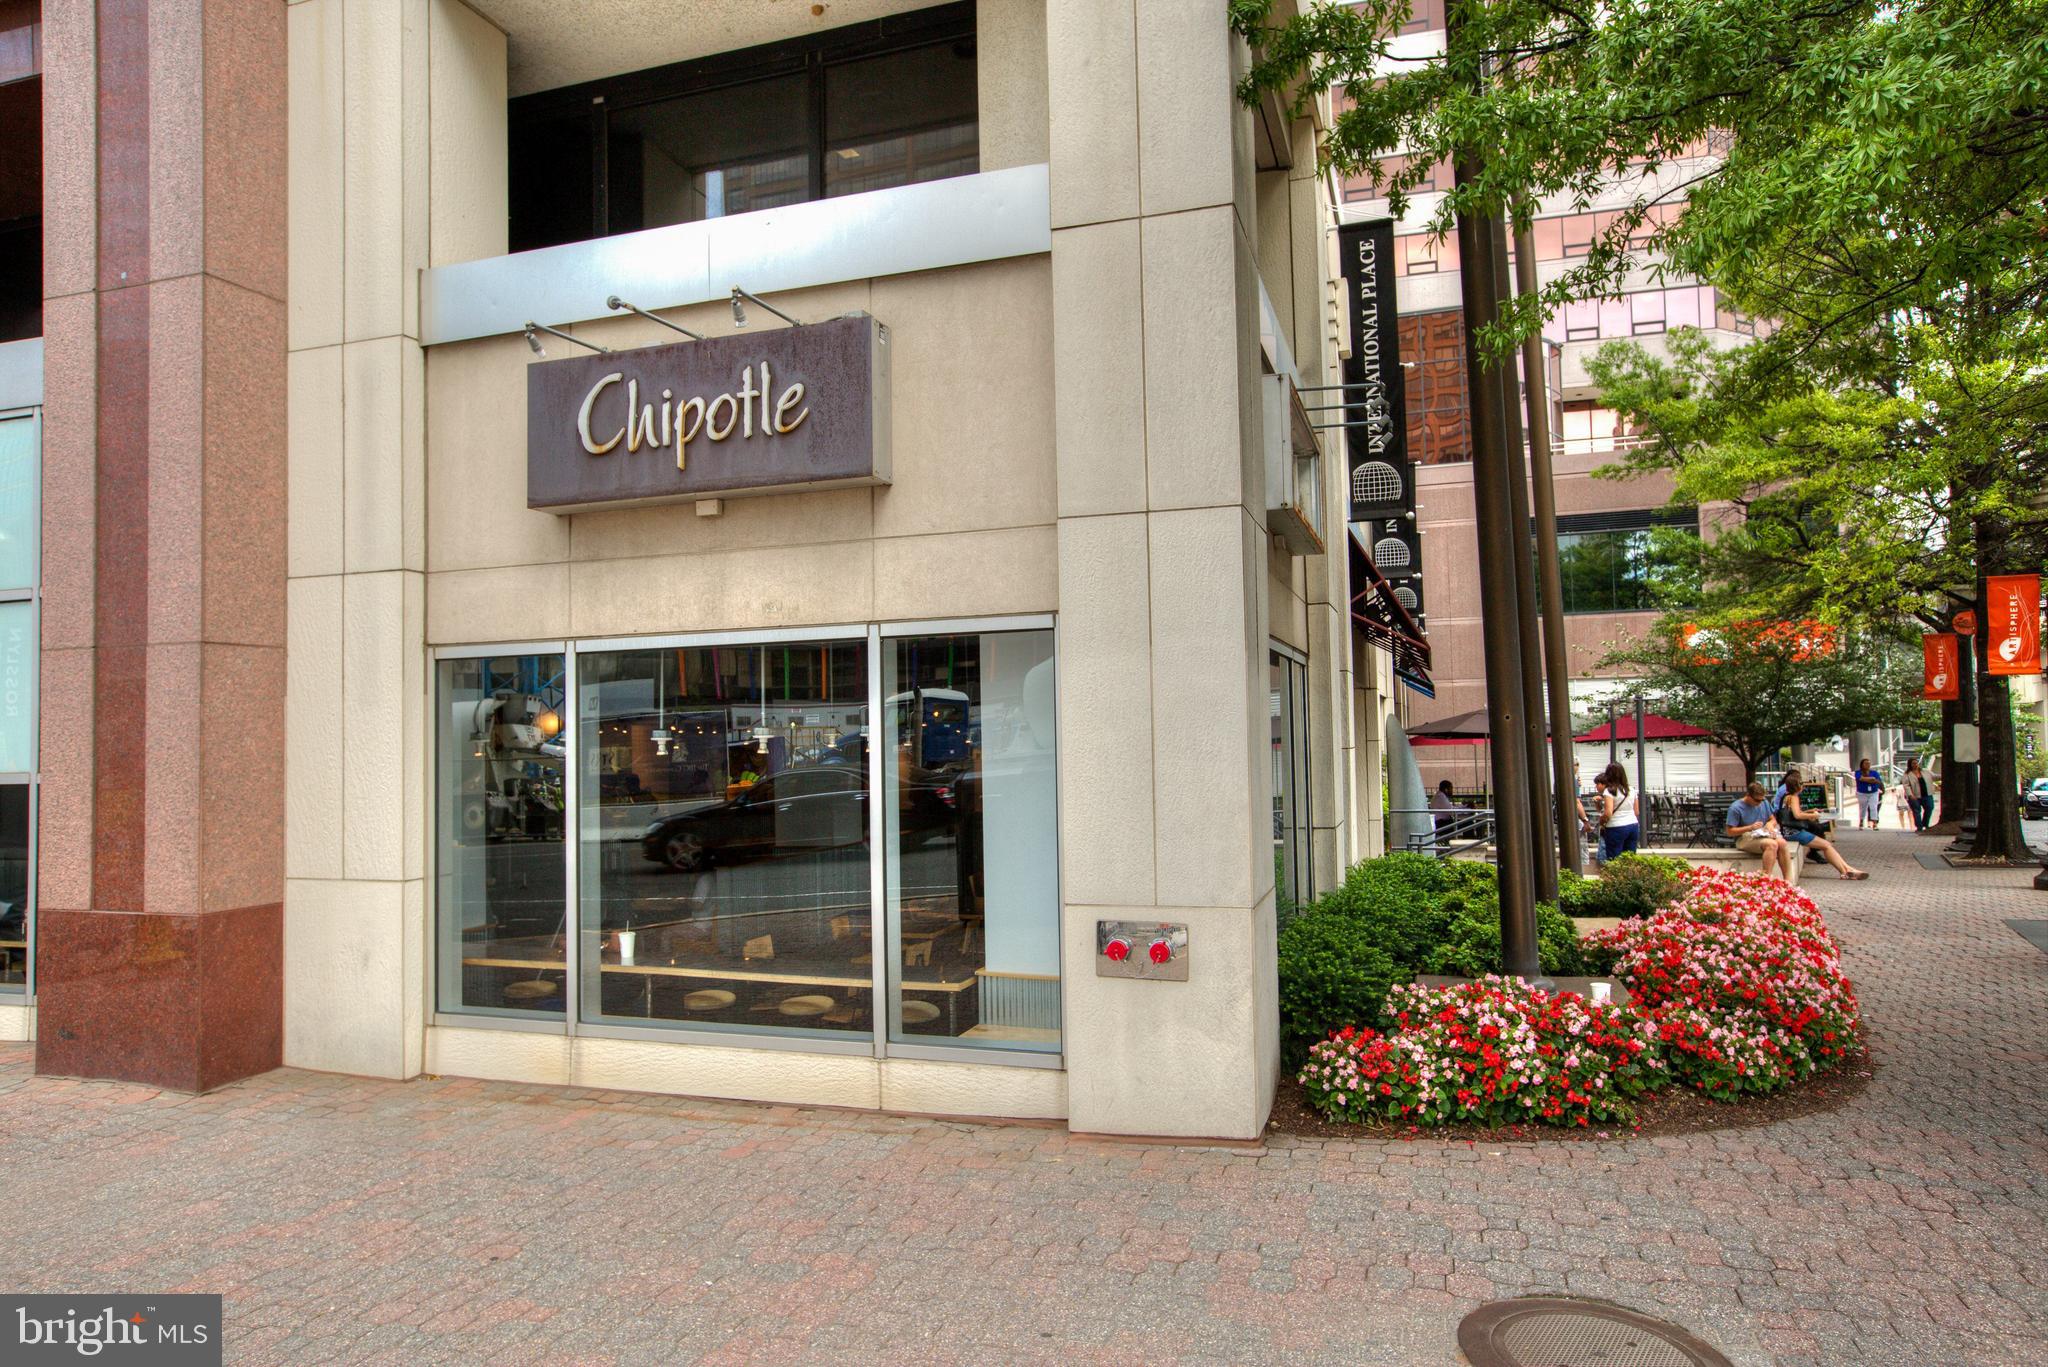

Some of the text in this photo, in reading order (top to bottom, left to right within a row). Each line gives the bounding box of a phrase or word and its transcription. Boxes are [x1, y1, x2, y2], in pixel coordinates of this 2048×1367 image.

[1360, 239, 1376, 300] PLACE
[577, 361, 809, 471] Chipotle
[2009, 594, 2018, 656] ARTISPHERE
